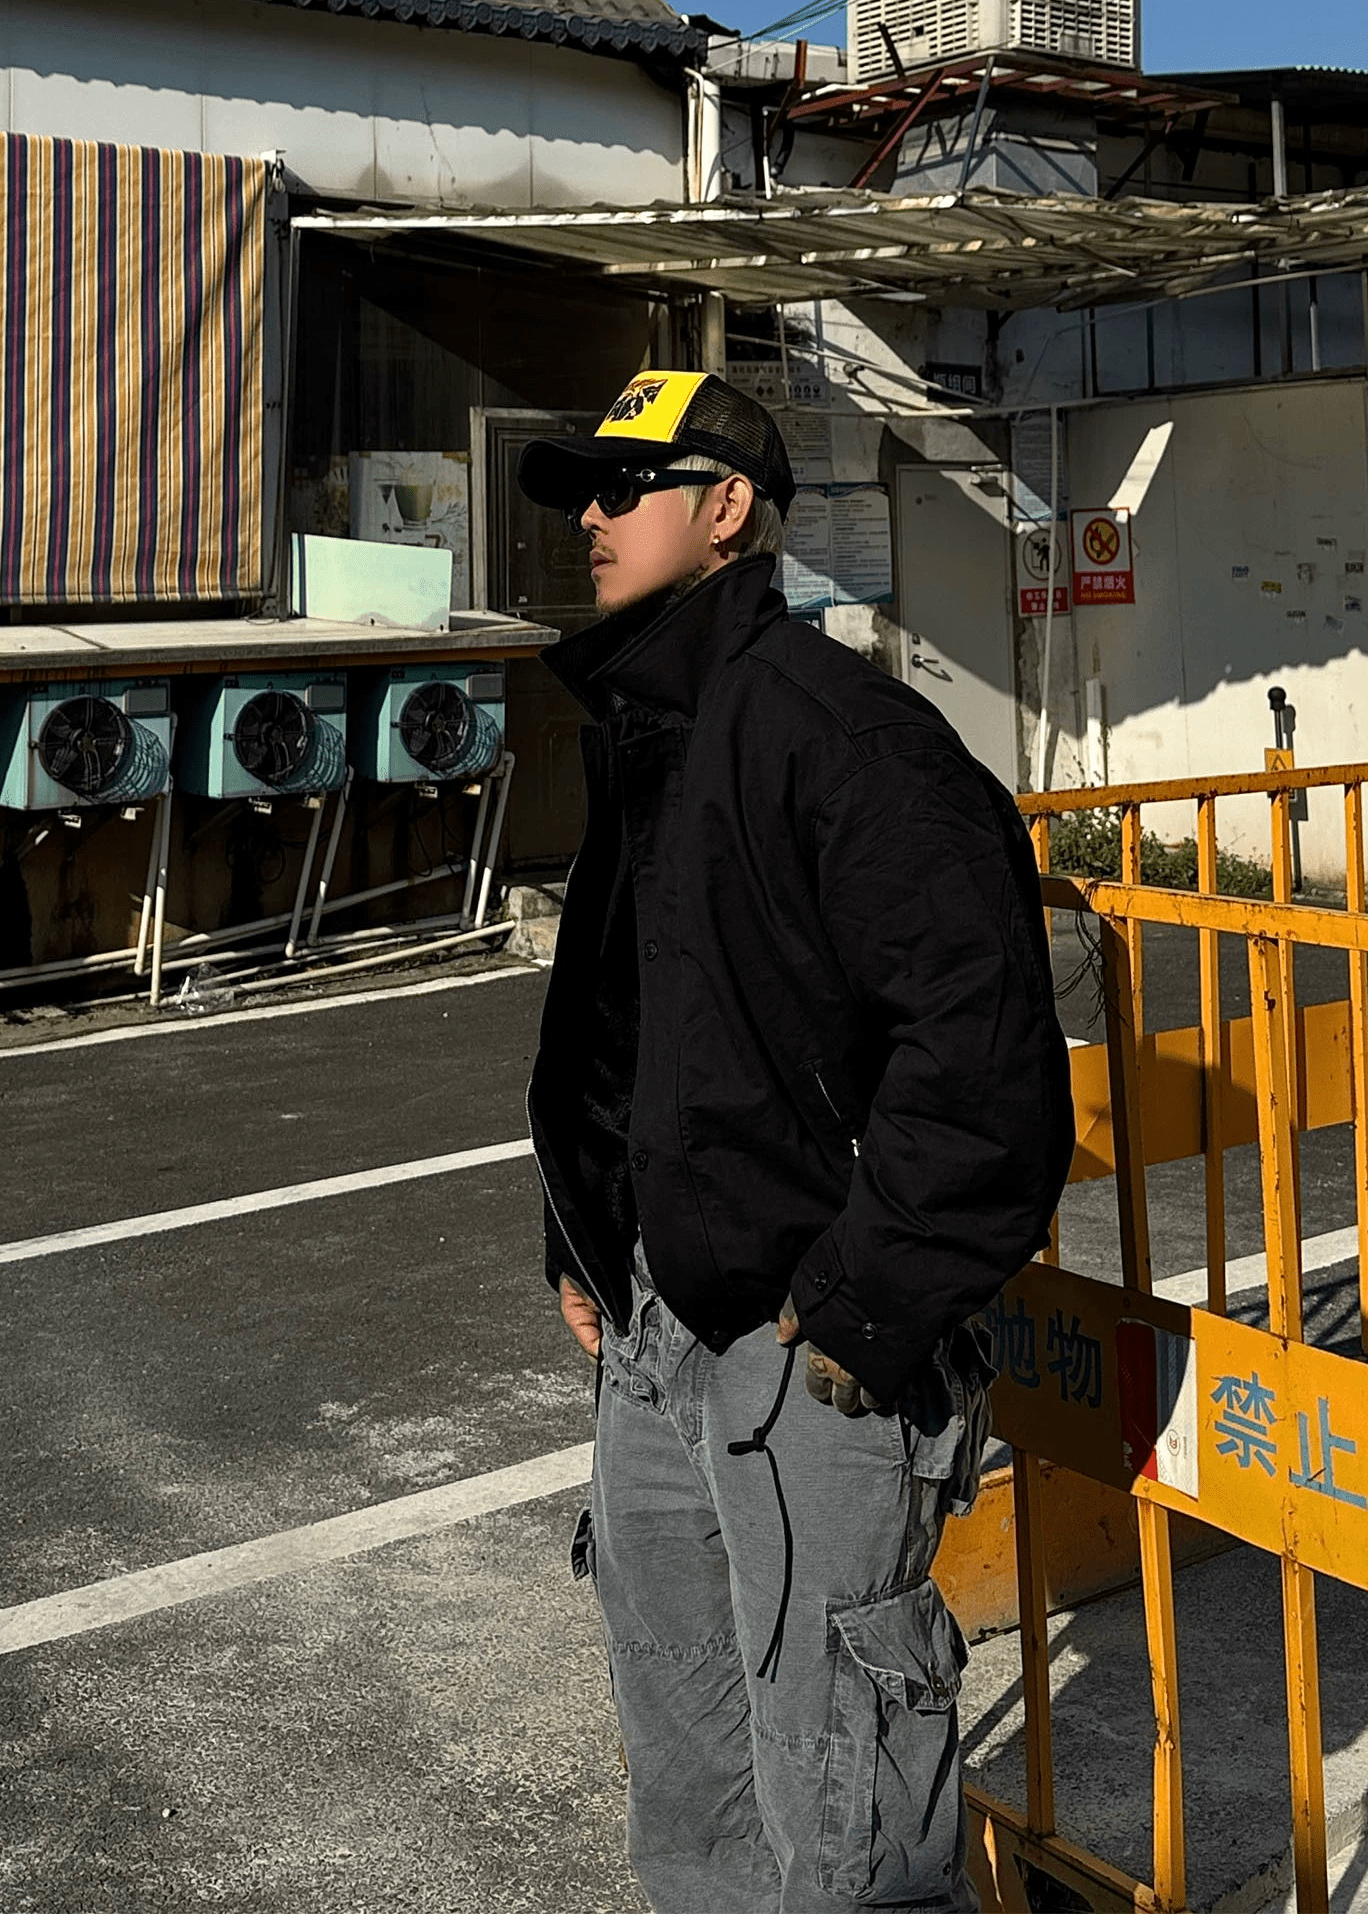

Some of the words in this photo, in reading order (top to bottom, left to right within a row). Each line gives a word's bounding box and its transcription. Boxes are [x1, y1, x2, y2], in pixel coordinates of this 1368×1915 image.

[1080, 575, 1127, 590] 严禁烟火
[984, 1293, 1103, 1409] 抛物
[1210, 1371, 1368, 1509] 禁止
